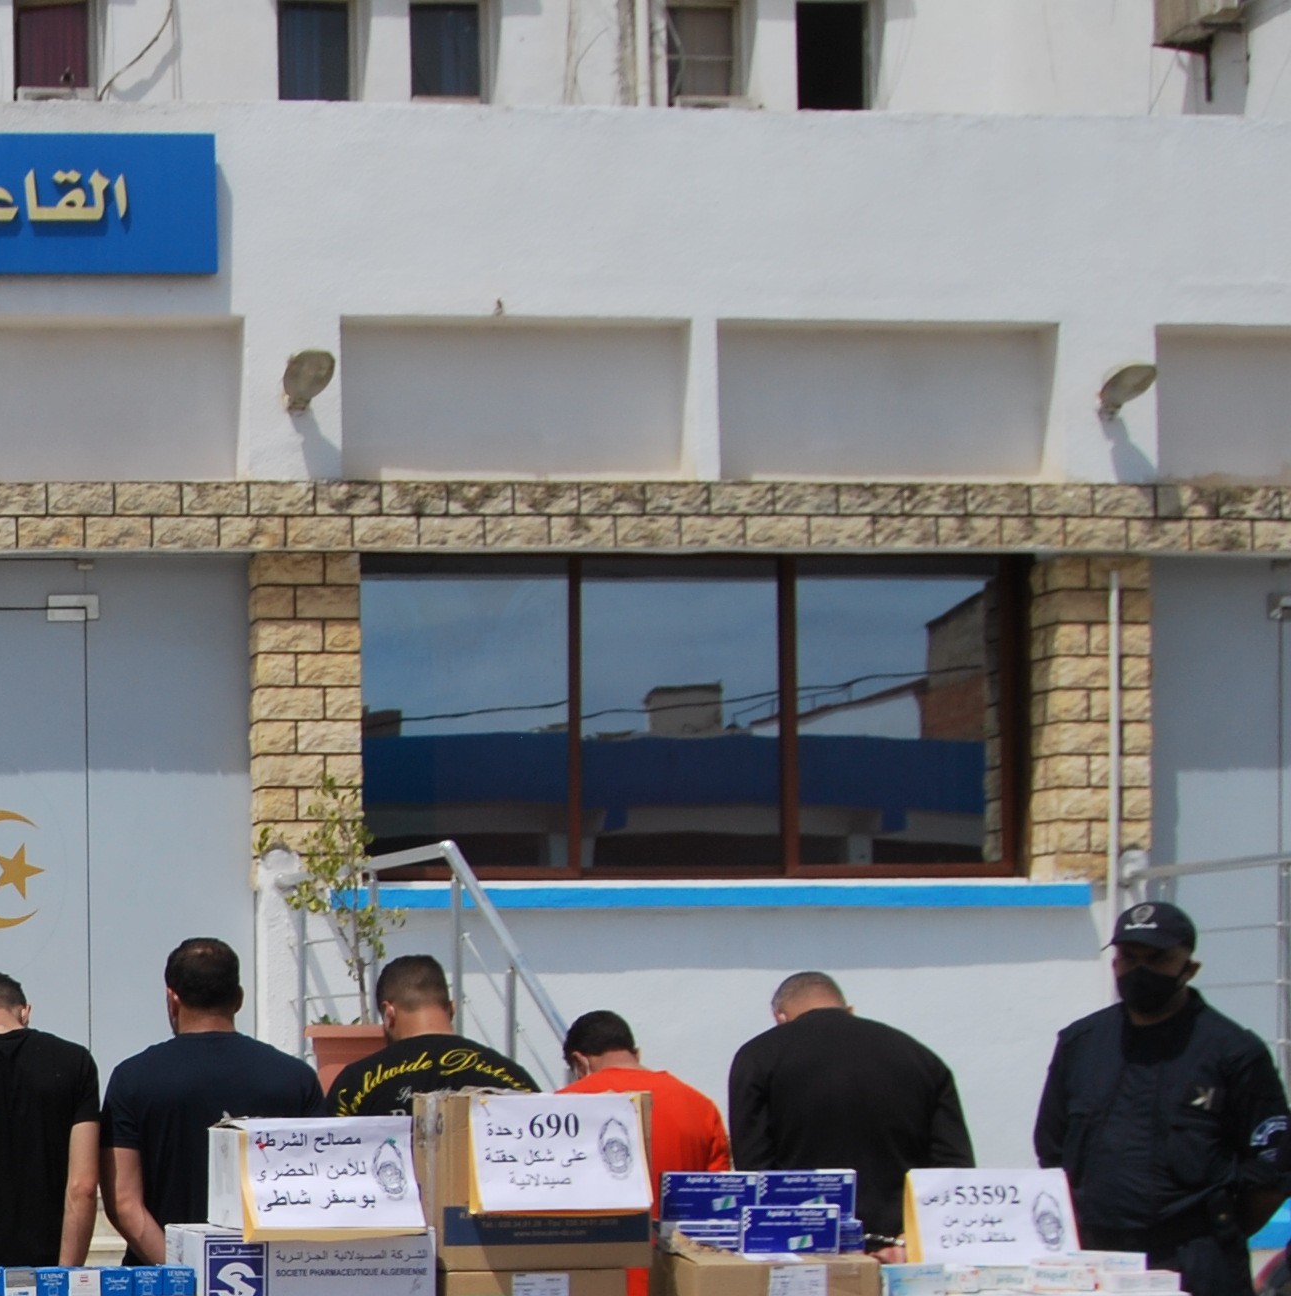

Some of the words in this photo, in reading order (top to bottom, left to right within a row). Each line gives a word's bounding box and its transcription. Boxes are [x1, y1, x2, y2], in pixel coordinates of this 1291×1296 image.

[439, 1048, 532, 1093] Distri
[486, 1122, 523, 1139] وحدة
[529, 1112, 580, 1138] 690
[255, 1131, 307, 1151] الشرطة
[314, 1132, 361, 1153] مصالح
[524, 1148, 554, 1166] شكل
[561, 1149, 587, 1167] على
[257, 1161, 319, 1182] الحضري
[327, 1158, 366, 1179] للأمن
[509, 1172, 571, 1190] صيدلانية
[954, 1186, 1021, 1205] 53592
[276, 1269, 307, 1277] SOCIETE
[309, 1268, 379, 1277] PHARMACEUTIQUE
[380, 1267, 427, 1276] ALGERIENNE
